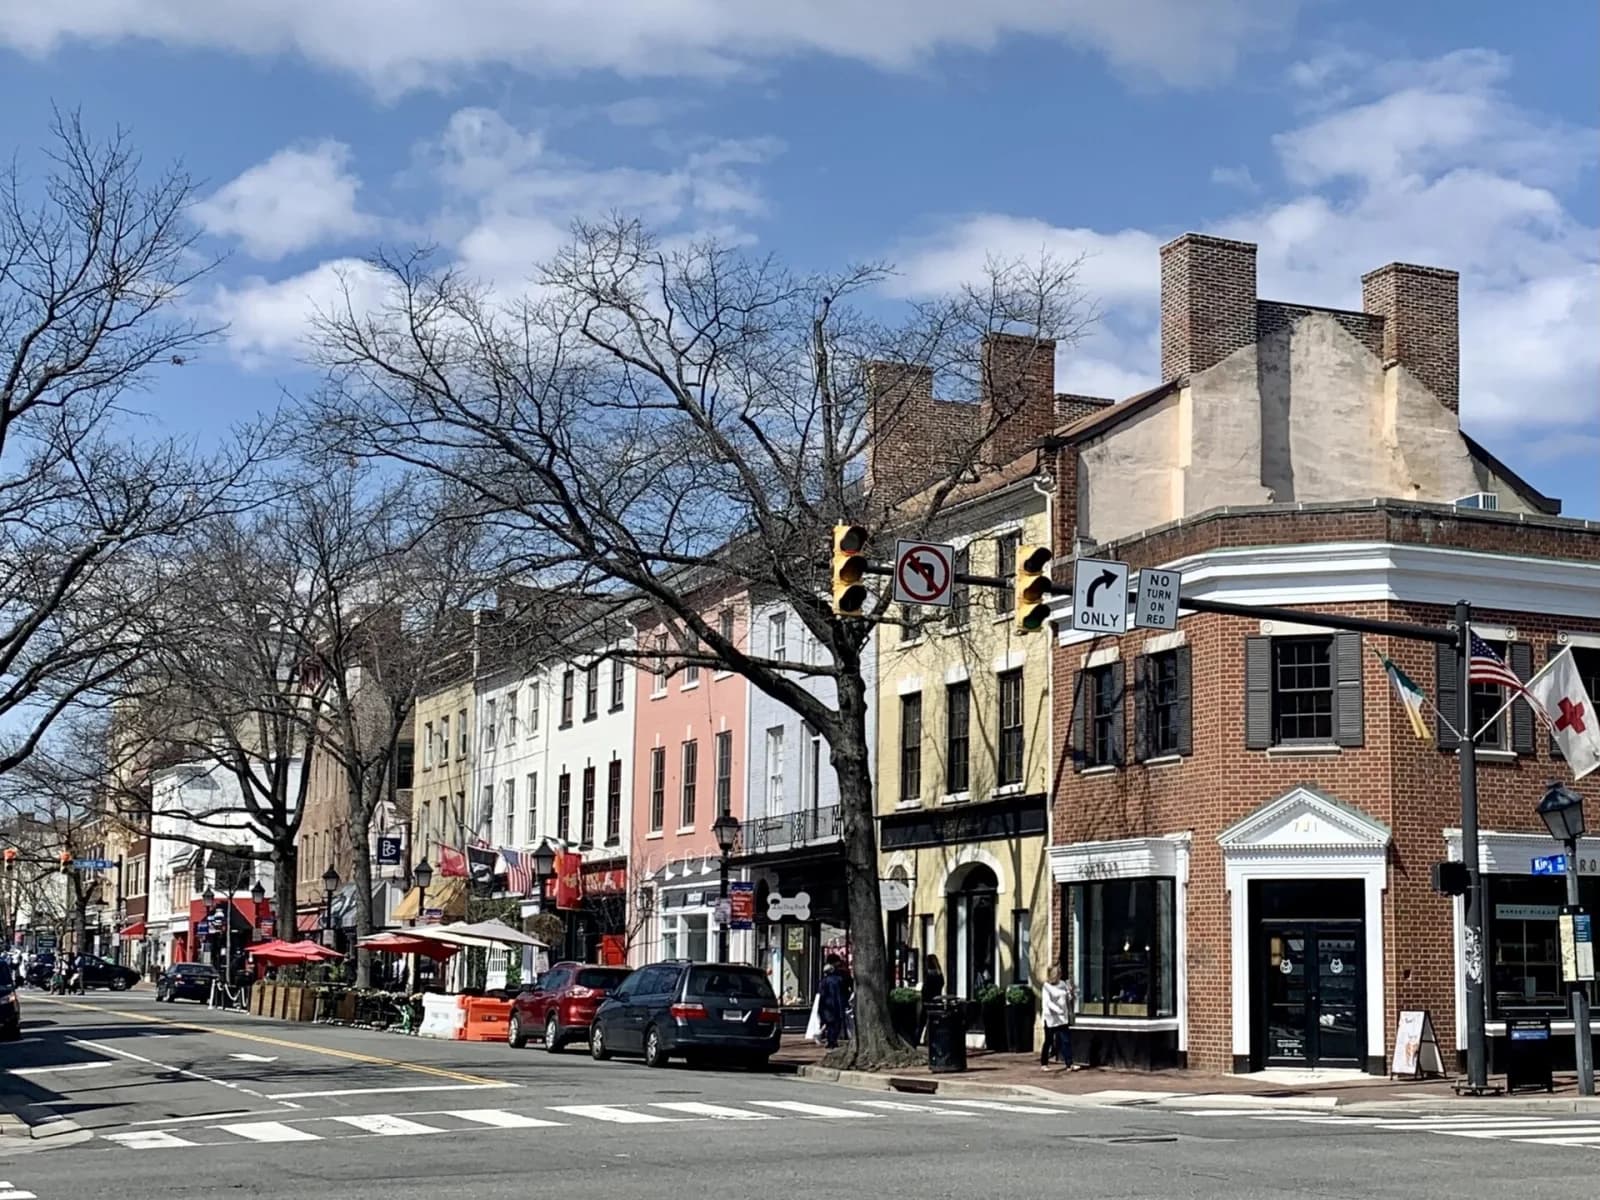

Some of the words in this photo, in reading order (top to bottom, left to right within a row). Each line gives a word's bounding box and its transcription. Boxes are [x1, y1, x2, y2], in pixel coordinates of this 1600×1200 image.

[1151, 574, 1170, 587] NO
[1147, 588, 1171, 600] TURN
[1150, 601, 1164, 612] ON
[1081, 611, 1119, 628] ONLY
[1146, 614, 1165, 625] RED
[1534, 858, 1553, 873] King
